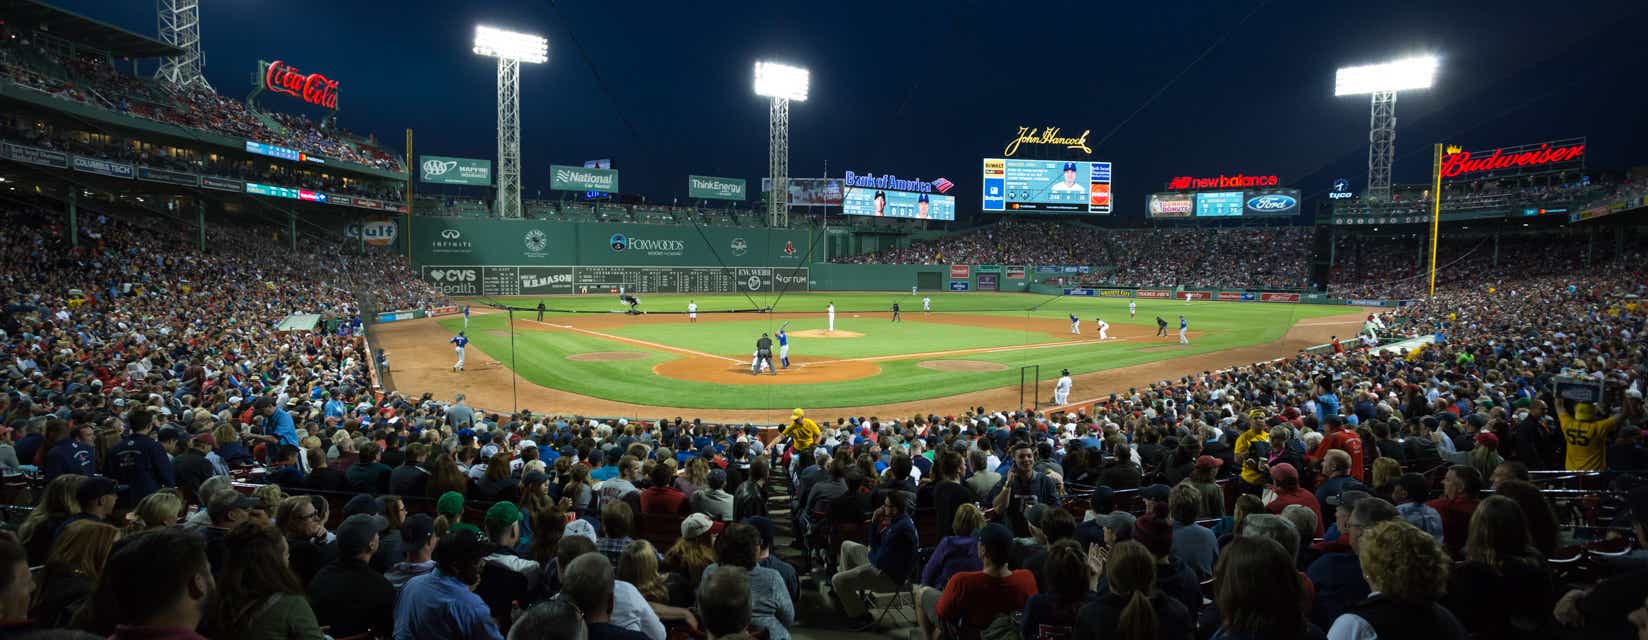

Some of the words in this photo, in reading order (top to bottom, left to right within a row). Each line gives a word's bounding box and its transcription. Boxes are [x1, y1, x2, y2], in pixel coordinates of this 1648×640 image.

[1005, 126, 1040, 156] John
[1040, 126, 1093, 154] Hancock
[1440, 143, 1585, 178] Budweiser
[569, 171, 614, 184] National
[845, 170, 875, 188] Bank
[876, 175, 888, 189] of
[889, 176, 931, 192] America
[1192, 178, 1219, 188] new
[1219, 173, 1278, 187] balance
[693, 179, 742, 194] ThinkEnergy
[1257, 197, 1287, 209] Ford
[1328, 191, 1352, 200] tyco
[627, 237, 685, 252] FOXWOODS
[446, 269, 477, 281] CVS
[1566, 428, 1590, 447] 55
